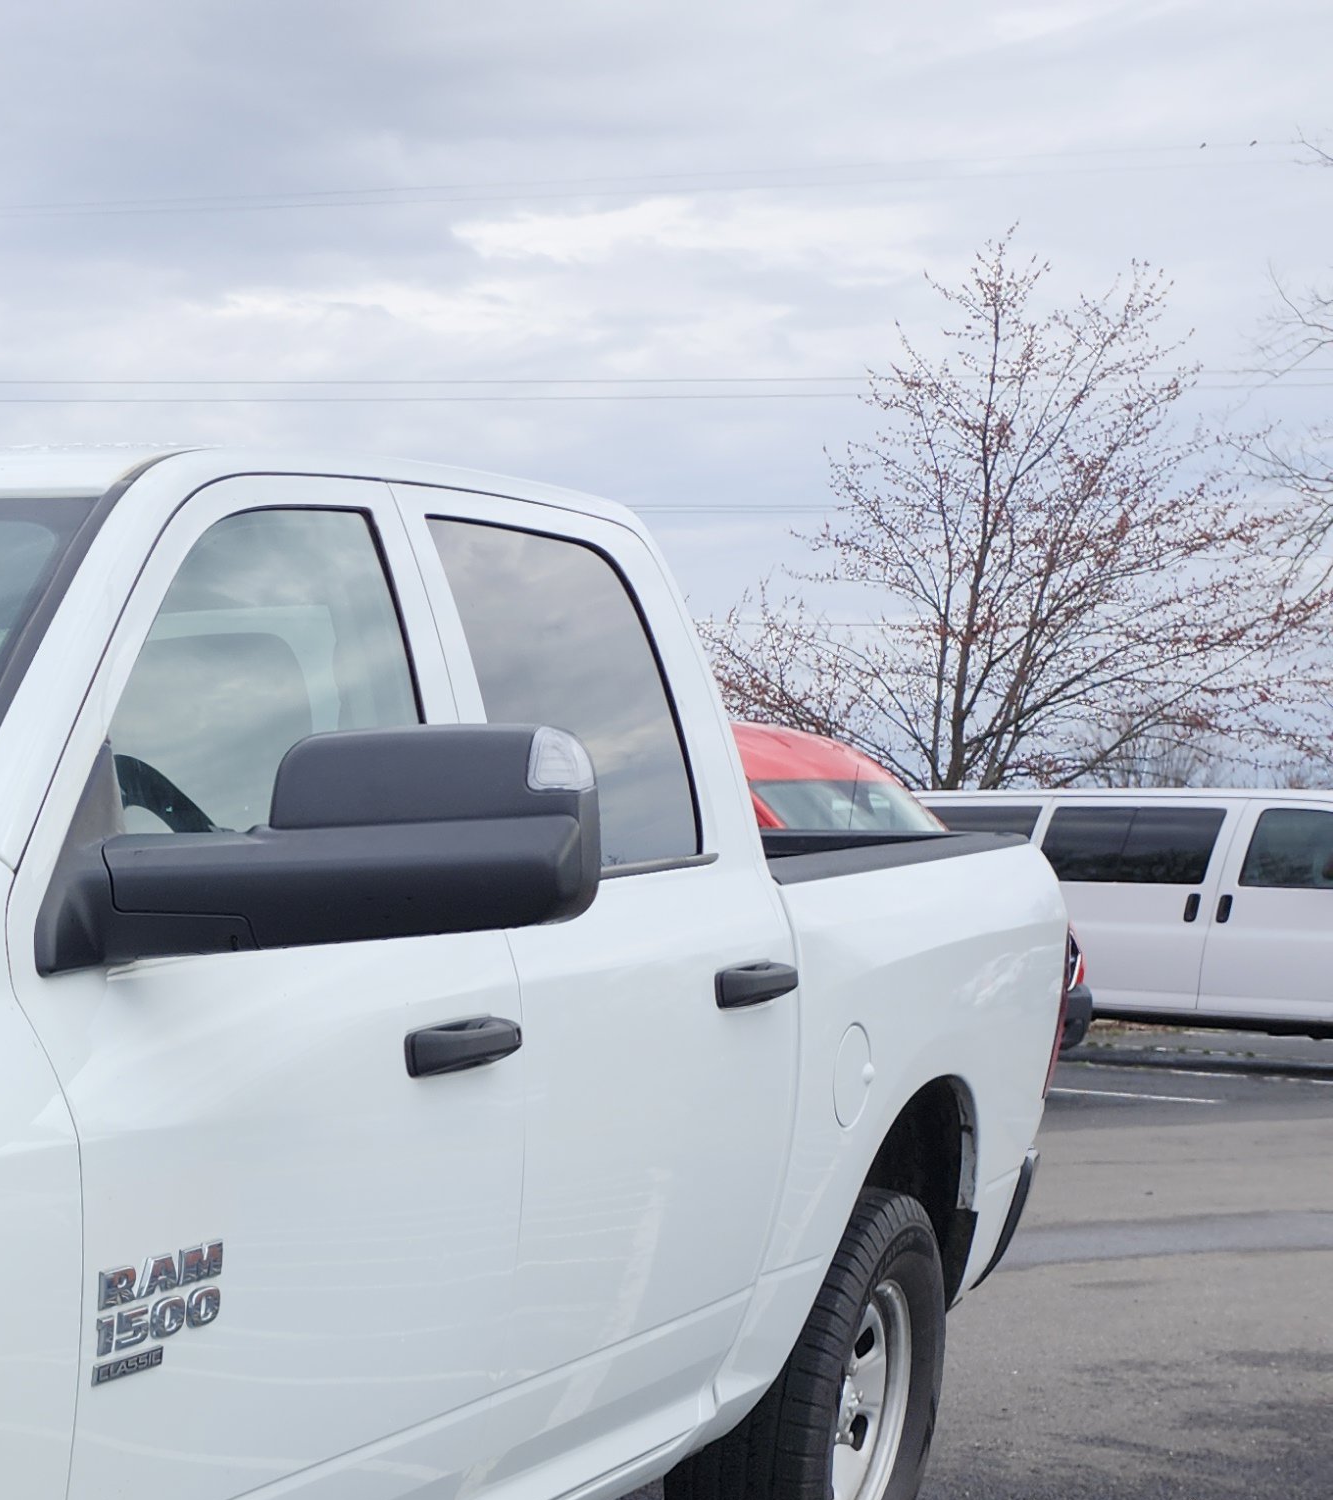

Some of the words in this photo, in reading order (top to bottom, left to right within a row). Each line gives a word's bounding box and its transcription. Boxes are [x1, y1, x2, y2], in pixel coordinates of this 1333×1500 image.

[98, 1239, 223, 1311] RAM
[96, 1285, 221, 1357] 1500
[98, 1347, 162, 1382] CLASSIC
